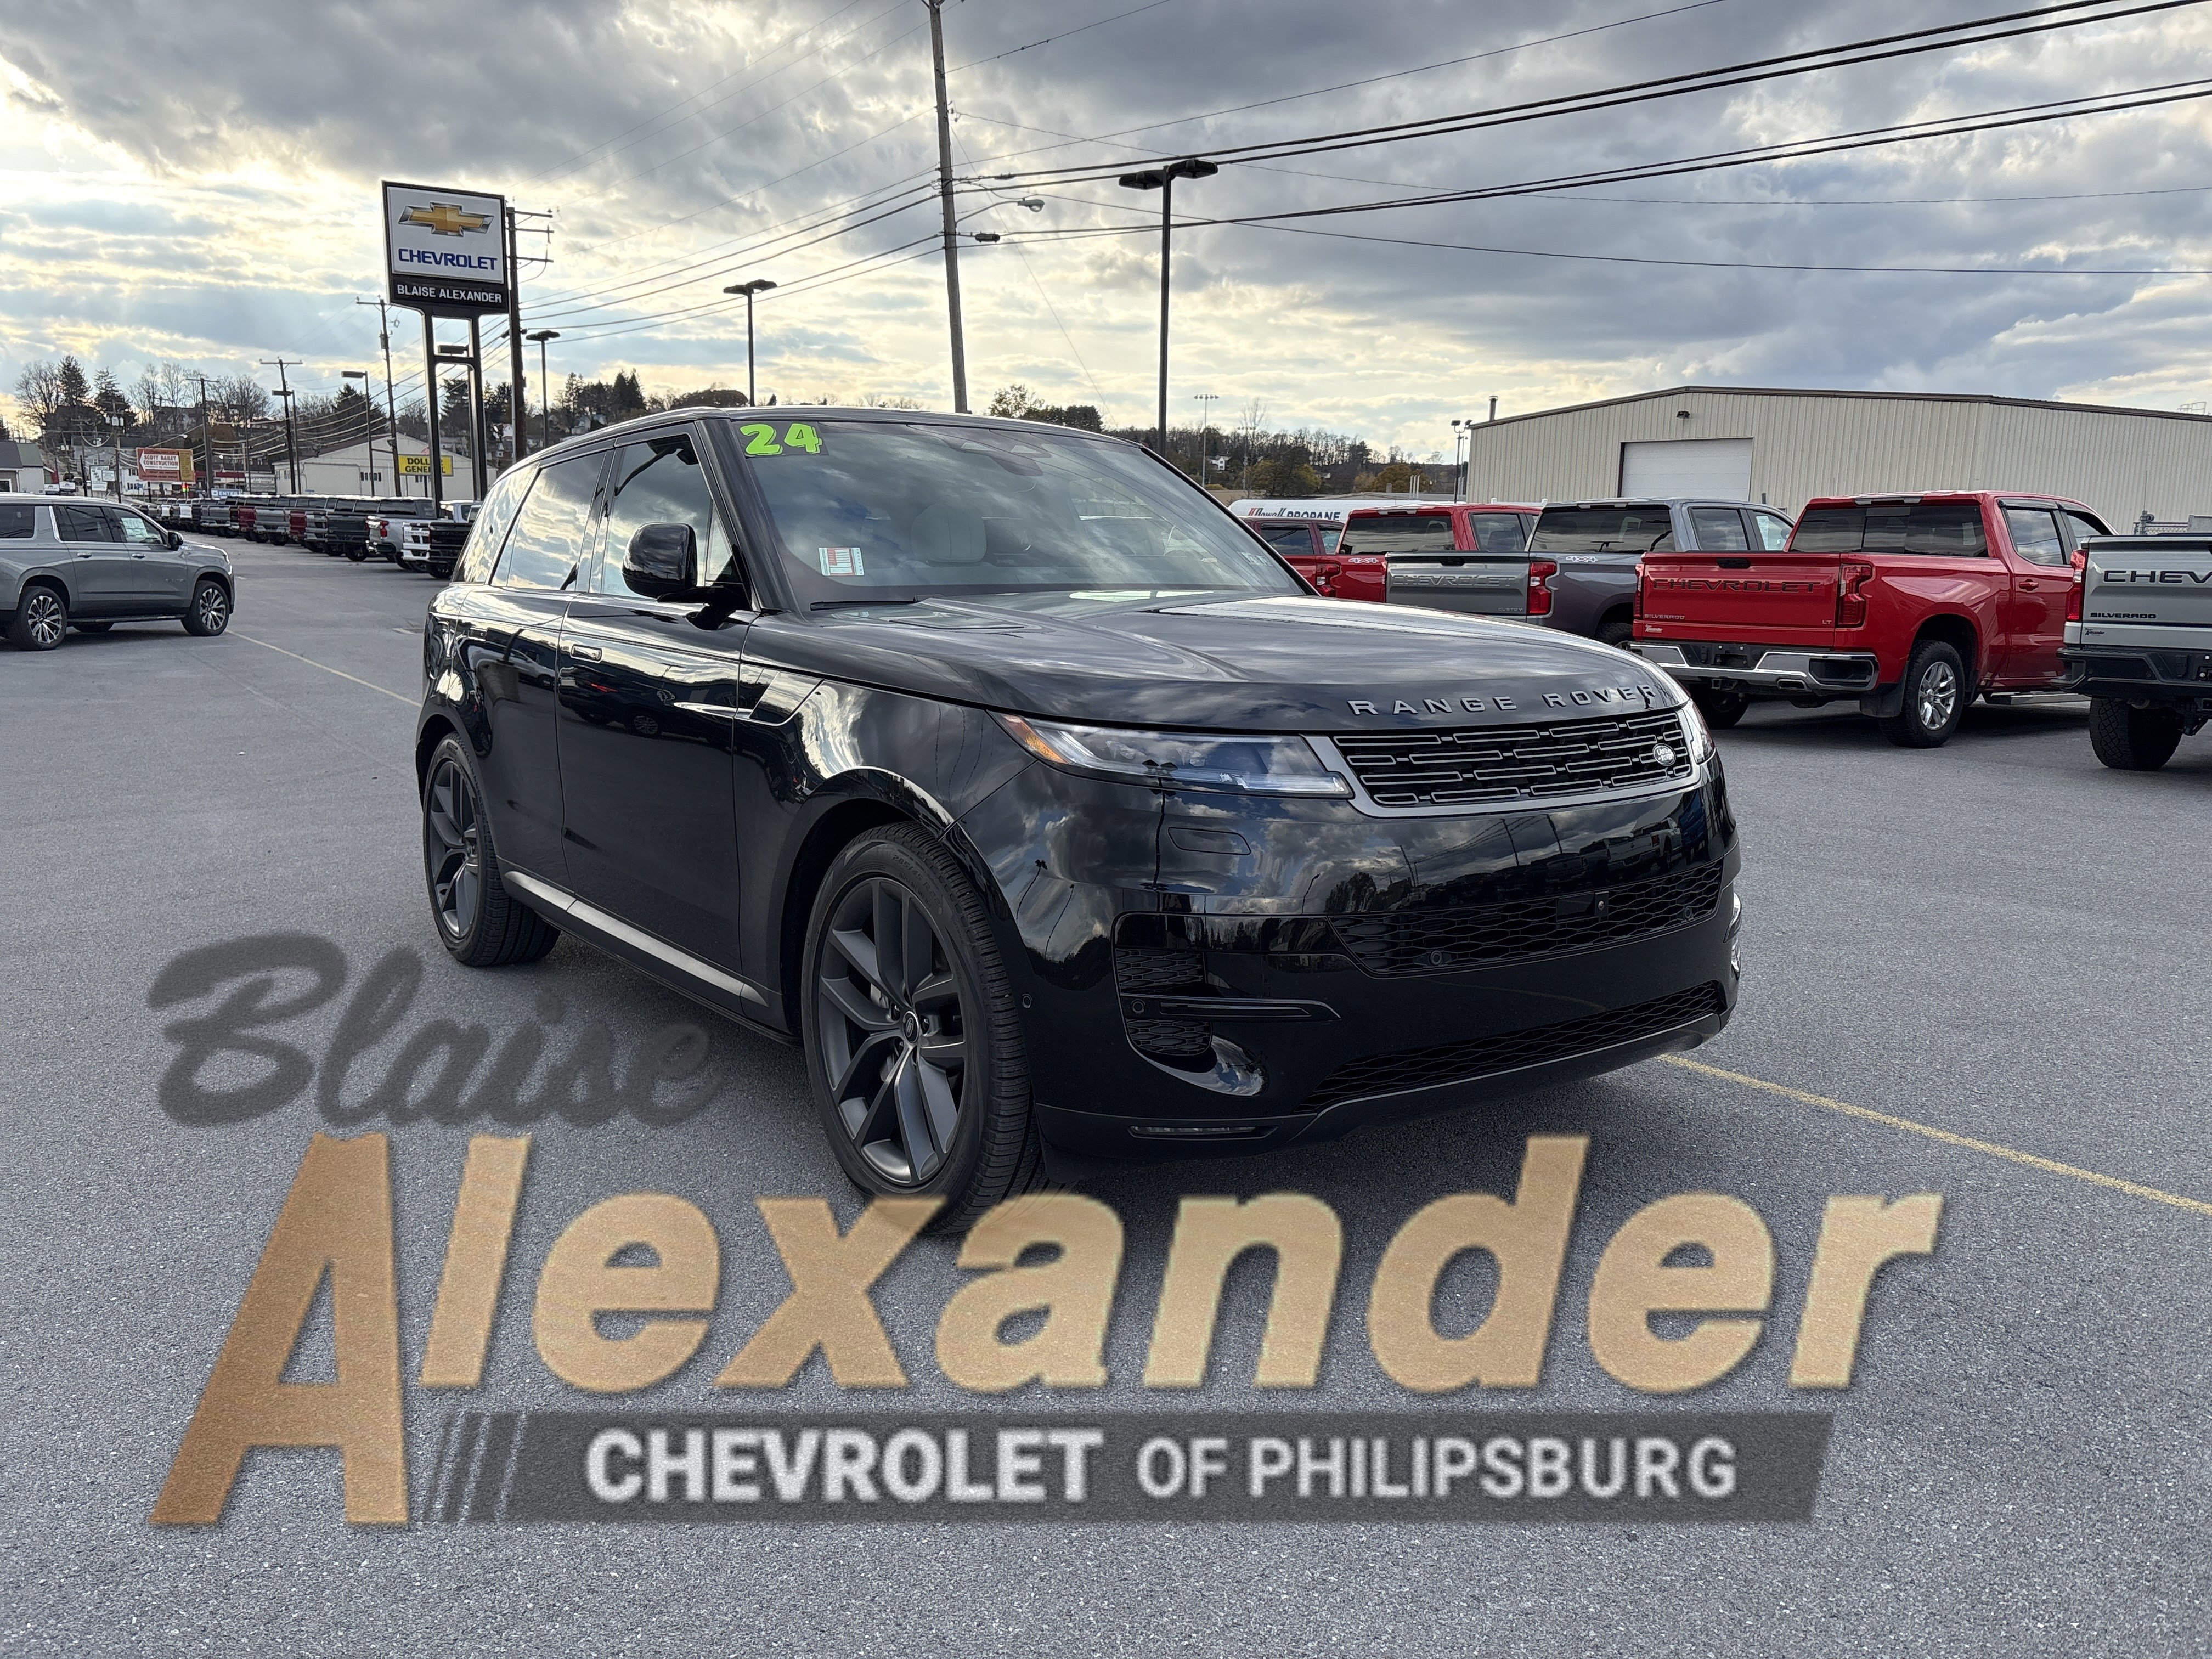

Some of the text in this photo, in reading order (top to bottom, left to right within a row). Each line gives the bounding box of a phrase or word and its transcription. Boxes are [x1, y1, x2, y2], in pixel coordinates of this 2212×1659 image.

[398, 248, 497, 270] CHEVROLET
[397, 284, 502, 303] BLAISE ALEXANDER
[740, 423, 822, 455] 24
[1287, 511, 1341, 521] PROPANE
[1392, 575, 1517, 586] CHEVROLET
[1652, 579, 1821, 594] CHEVROLET
[1347, 684, 1656, 715] RANGE ROVER
